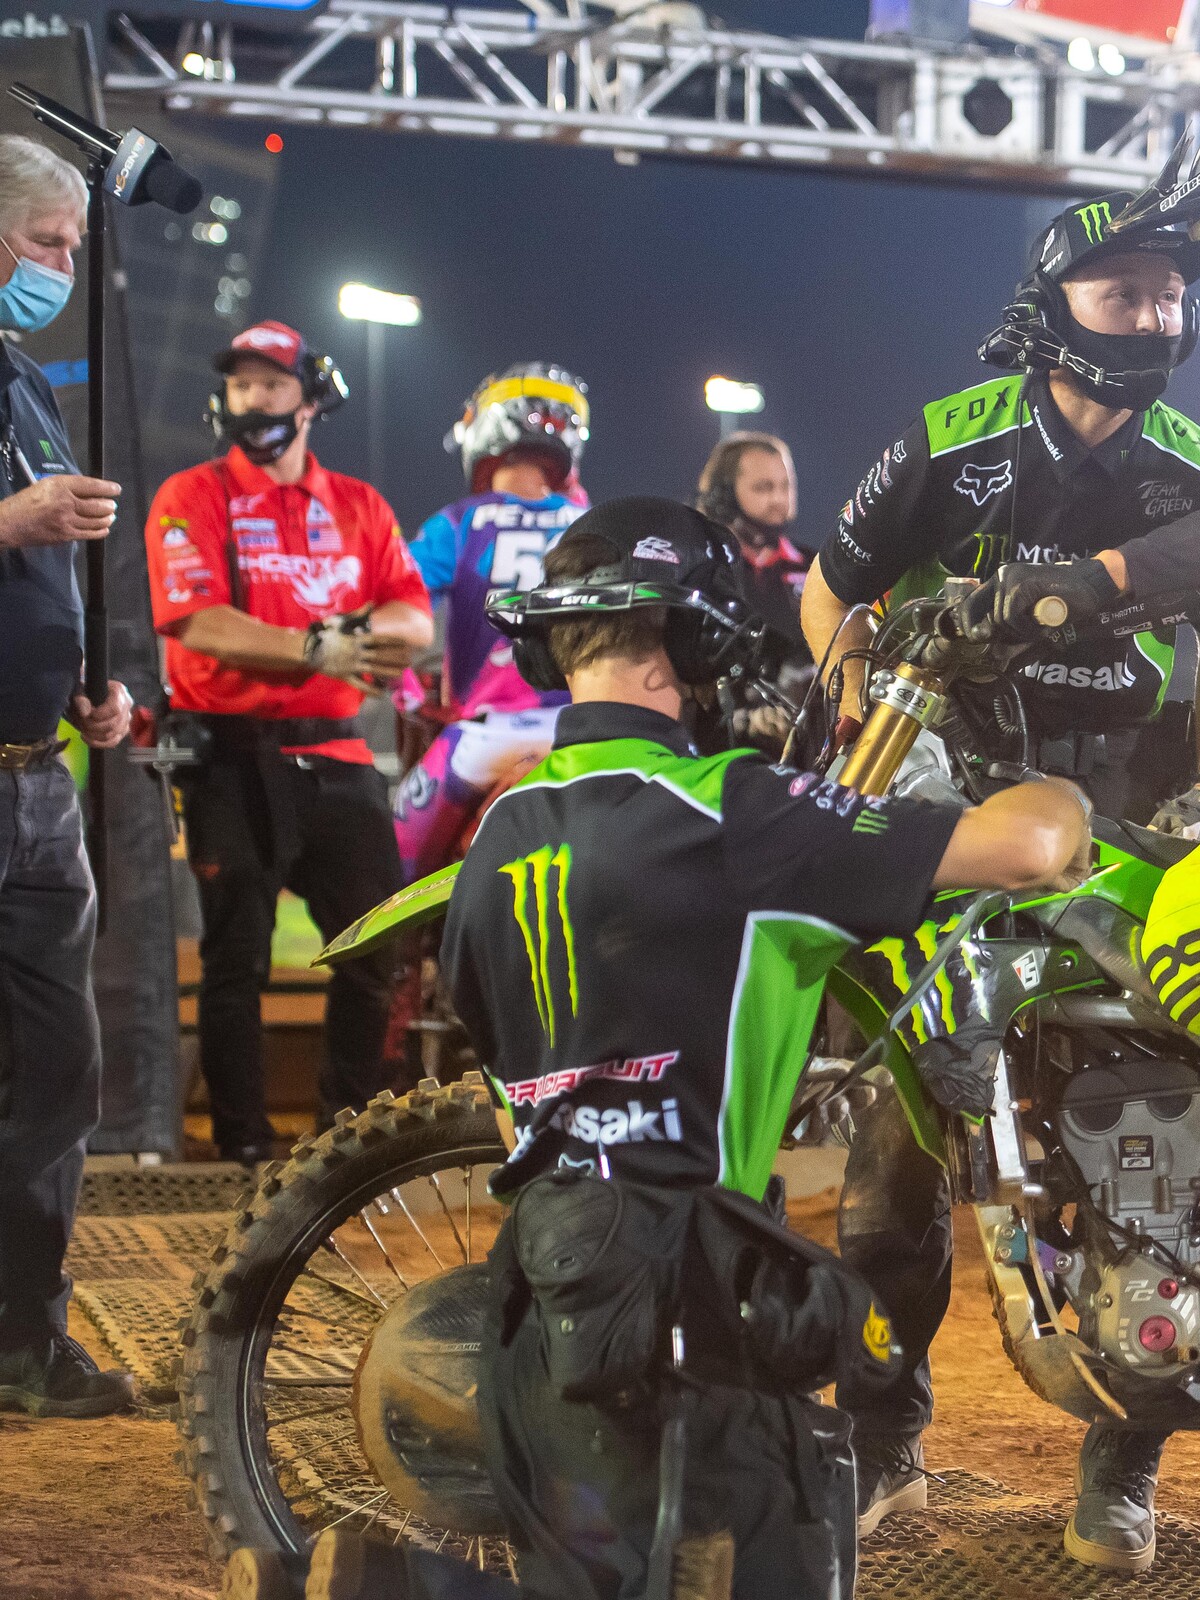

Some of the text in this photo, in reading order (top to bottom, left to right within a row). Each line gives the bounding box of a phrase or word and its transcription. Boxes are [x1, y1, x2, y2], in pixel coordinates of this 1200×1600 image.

[945, 386, 1010, 428] FOX
[1032, 405, 1064, 462] Kawasaki
[1138, 480, 1181, 499] TEAM
[1145, 500, 1193, 517] GREEN
[1161, 612, 1190, 625] RK
